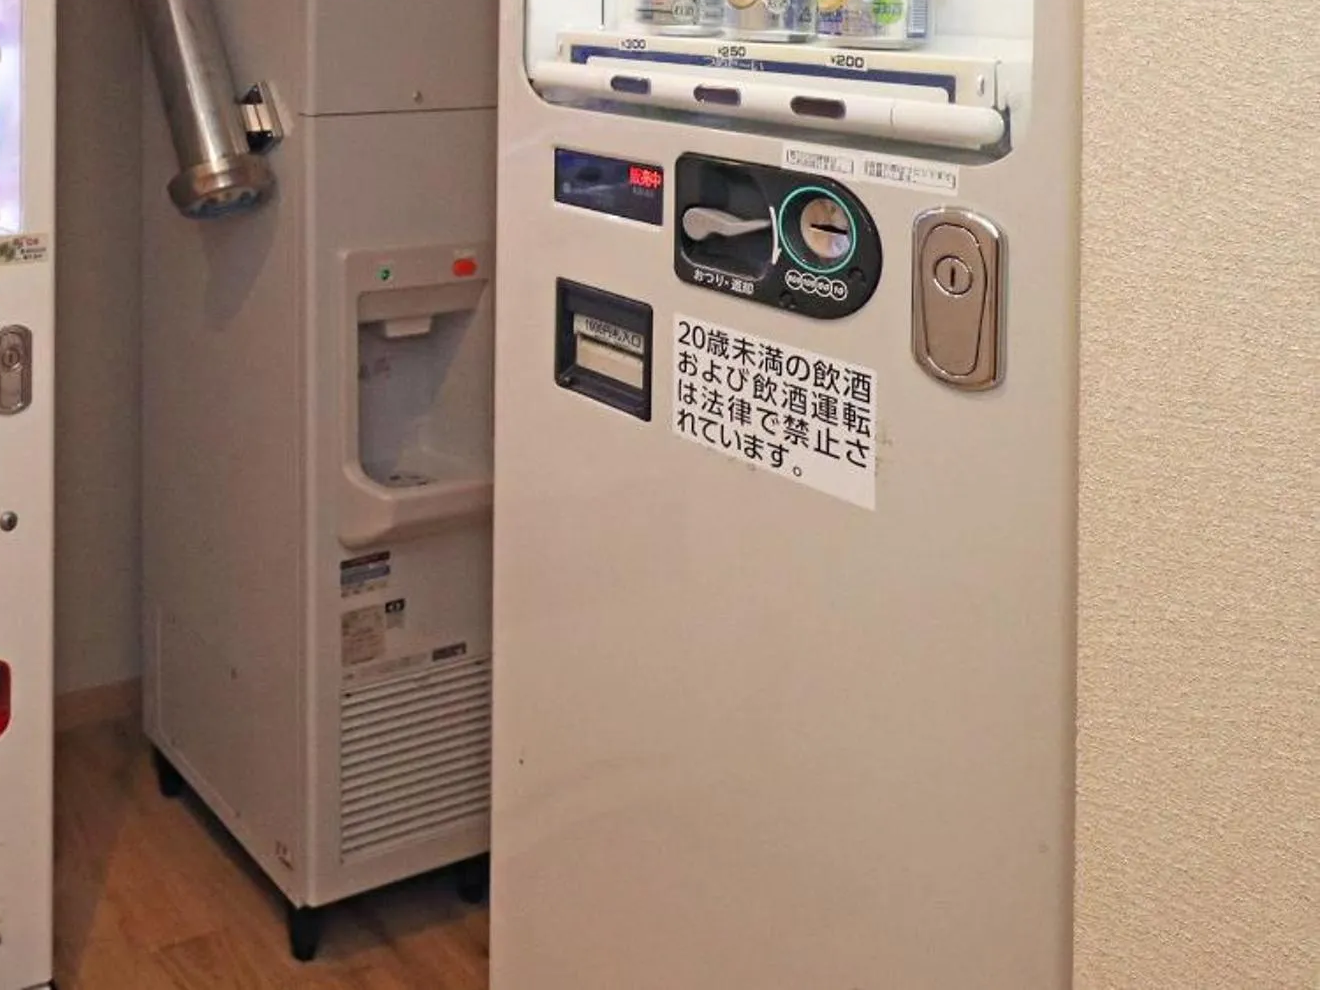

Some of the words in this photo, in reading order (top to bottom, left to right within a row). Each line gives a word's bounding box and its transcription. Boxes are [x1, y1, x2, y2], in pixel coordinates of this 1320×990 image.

[832, 55, 865, 69] ¥200
[678, 321, 872, 404] 20歳未満の飲酒
[678, 351, 871, 438] および飲酒運転
[677, 409, 803, 477] れています。
[678, 378, 871, 468] は法律で禁止さ
